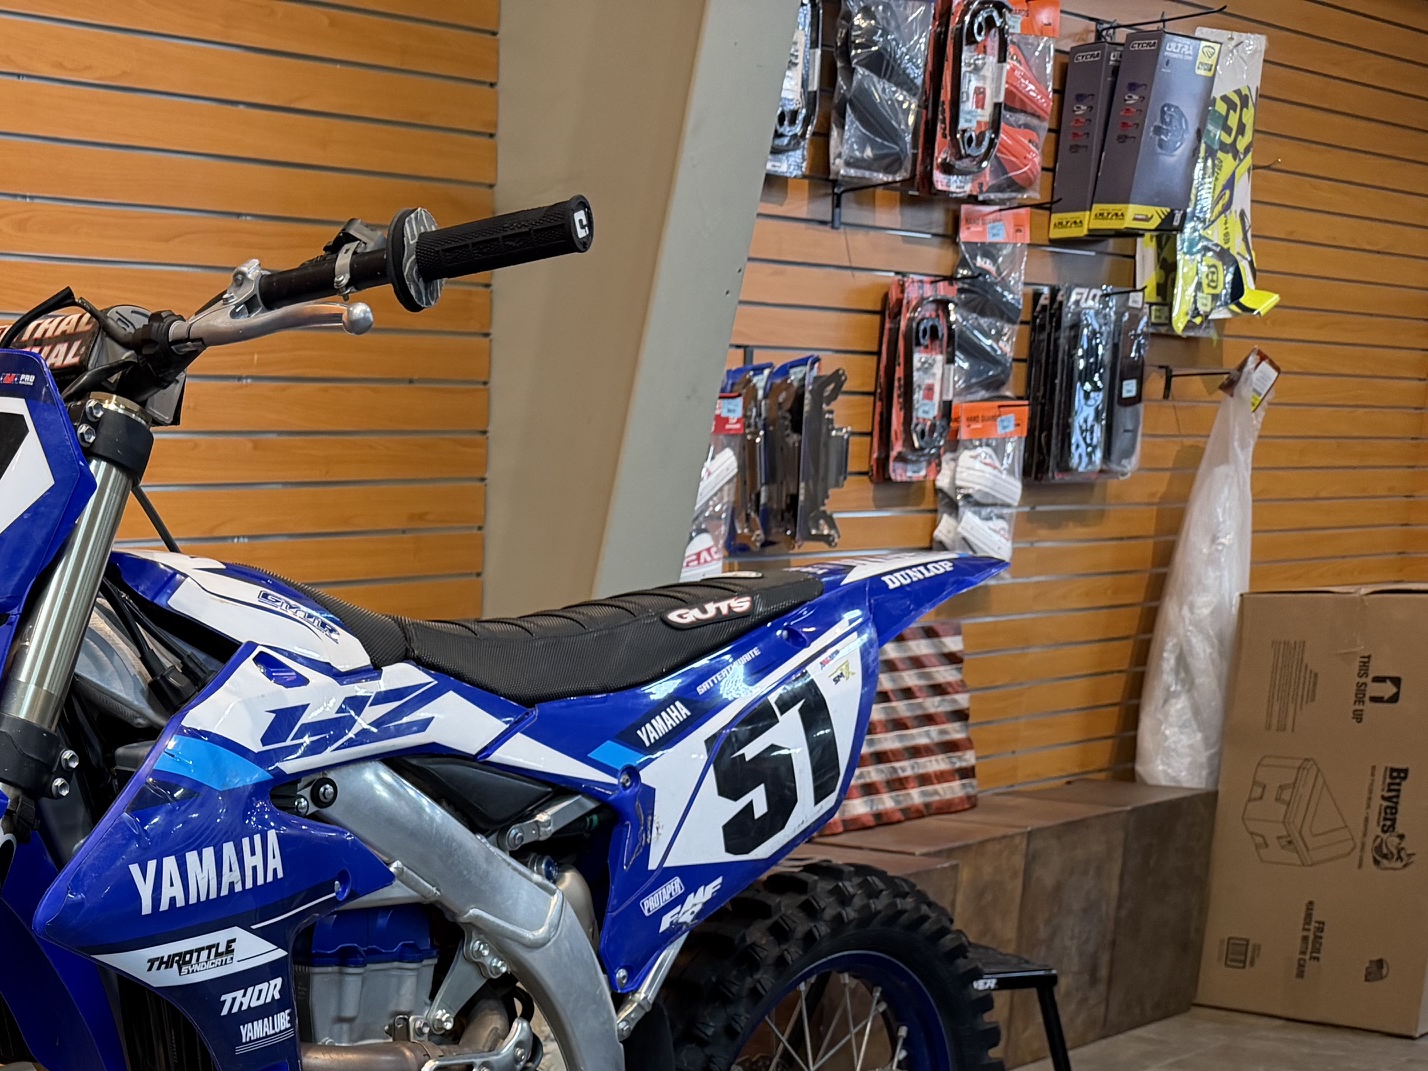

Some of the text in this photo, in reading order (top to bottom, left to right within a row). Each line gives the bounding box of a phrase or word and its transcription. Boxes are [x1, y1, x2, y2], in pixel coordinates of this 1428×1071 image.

[1074, 52, 1101, 62] CYCRA
[1131, 40, 1158, 50] CYCRA
[1166, 42, 1193, 55] ULTRA
[881, 560, 954, 590] DUNLOP
[666, 596, 753, 625] GUTS
[1351, 654, 1371, 724] THIS SIDE UP
[636, 700, 691, 748] YAMAHA
[1381, 766, 1409, 835] Buyers
[128, 829, 283, 916] YAMAHA
[642, 879, 682, 915] PROTAPER
[146, 938, 236, 972] THROTTLE
[1308, 919, 1325, 964] FRAGILE
[180, 957, 234, 976] SYNDICATE
[220, 977, 283, 1017] THOR
[240, 1009, 292, 1044] YAMALUBE
